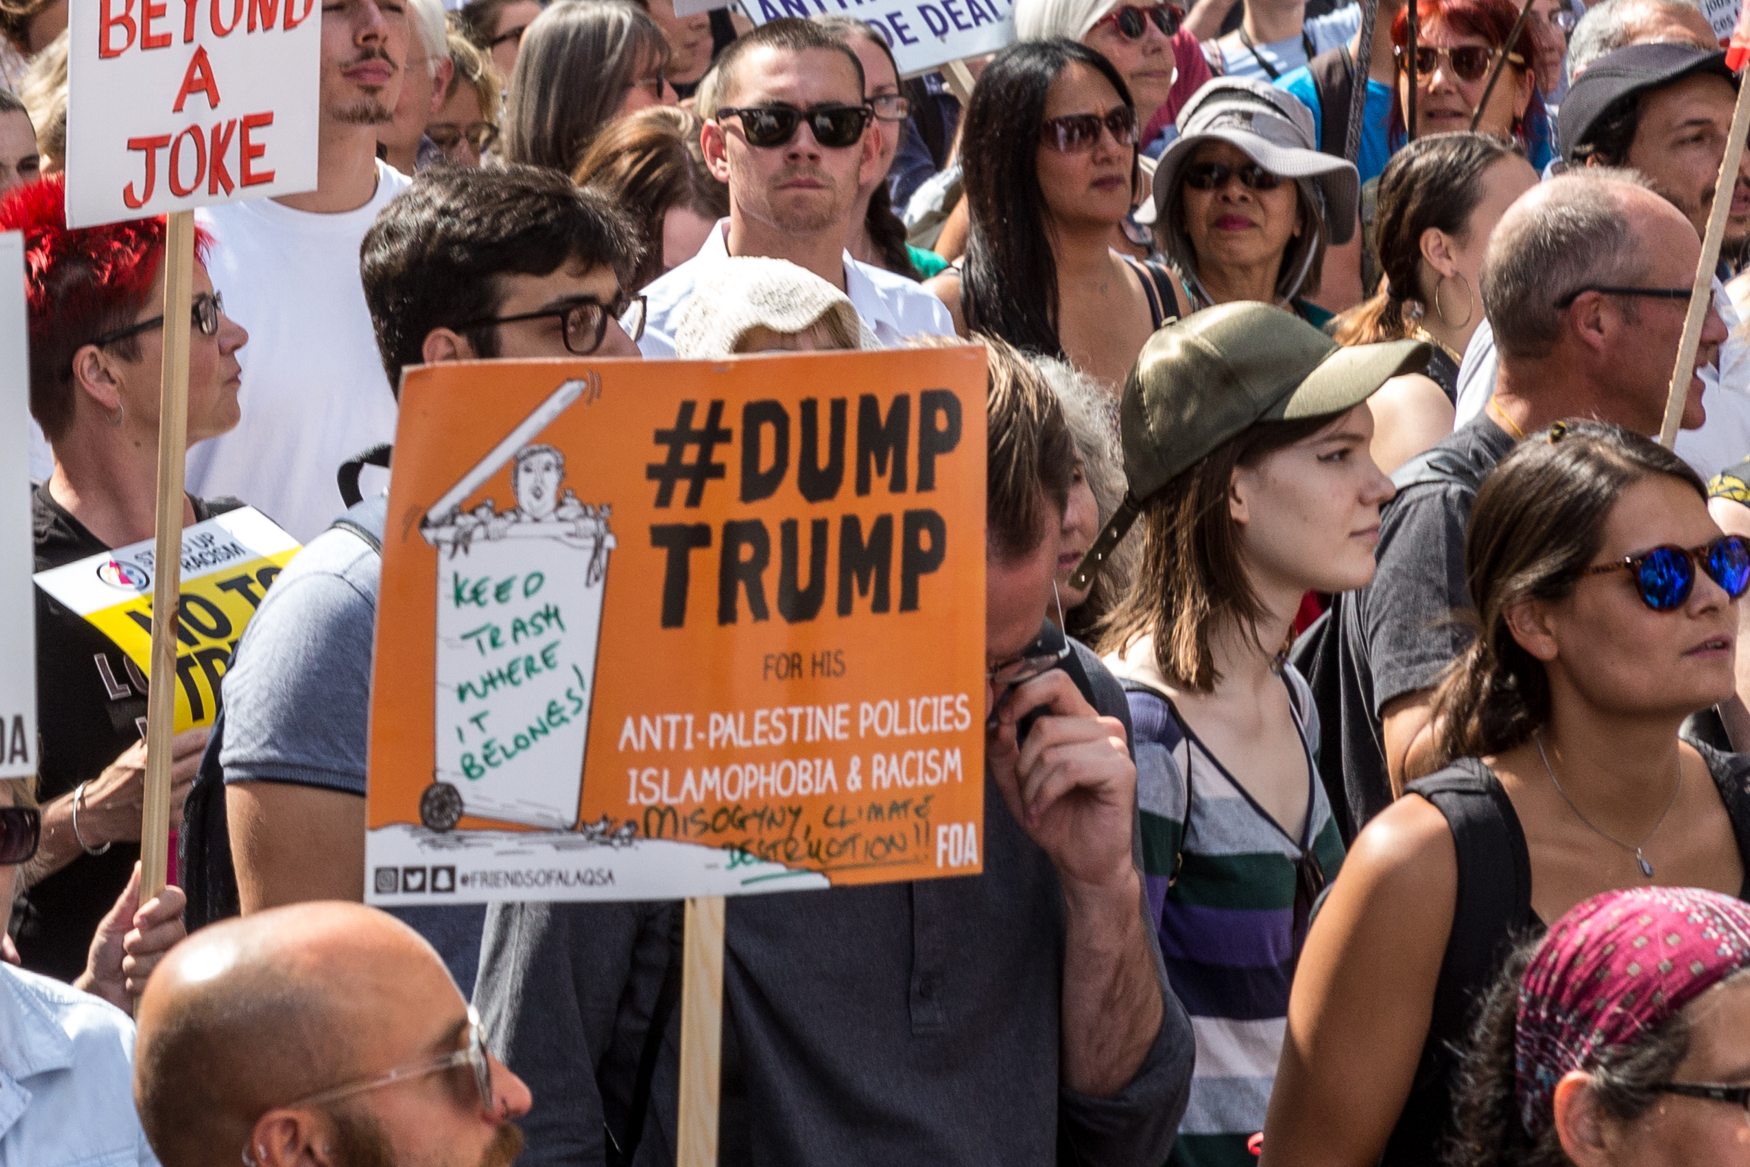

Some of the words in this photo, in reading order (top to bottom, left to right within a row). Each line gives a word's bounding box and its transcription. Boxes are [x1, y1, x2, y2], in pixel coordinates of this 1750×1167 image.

[172, 44, 221, 113] A
[123, 111, 275, 209] JOKE
[646, 389, 963, 508] #DUMP
[650, 508, 947, 630] TRUMP
[461, 604, 565, 657] TRASH
[457, 641, 559, 703] WHERE
[762, 653, 803, 681] FOR
[811, 650, 846, 678] HIS
[457, 710, 490, 743] IT
[619, 703, 849, 751] ANTI-PALESTINE
[859, 694, 971, 738] POLICIES
[628, 758, 838, 805] ISLAMOPHOBIA
[847, 757, 861, 791] &
[871, 749, 963, 790] RACISM
[937, 824, 978, 867] FOA
[460, 867, 615, 889] @FRIENDSOFALAQSA
